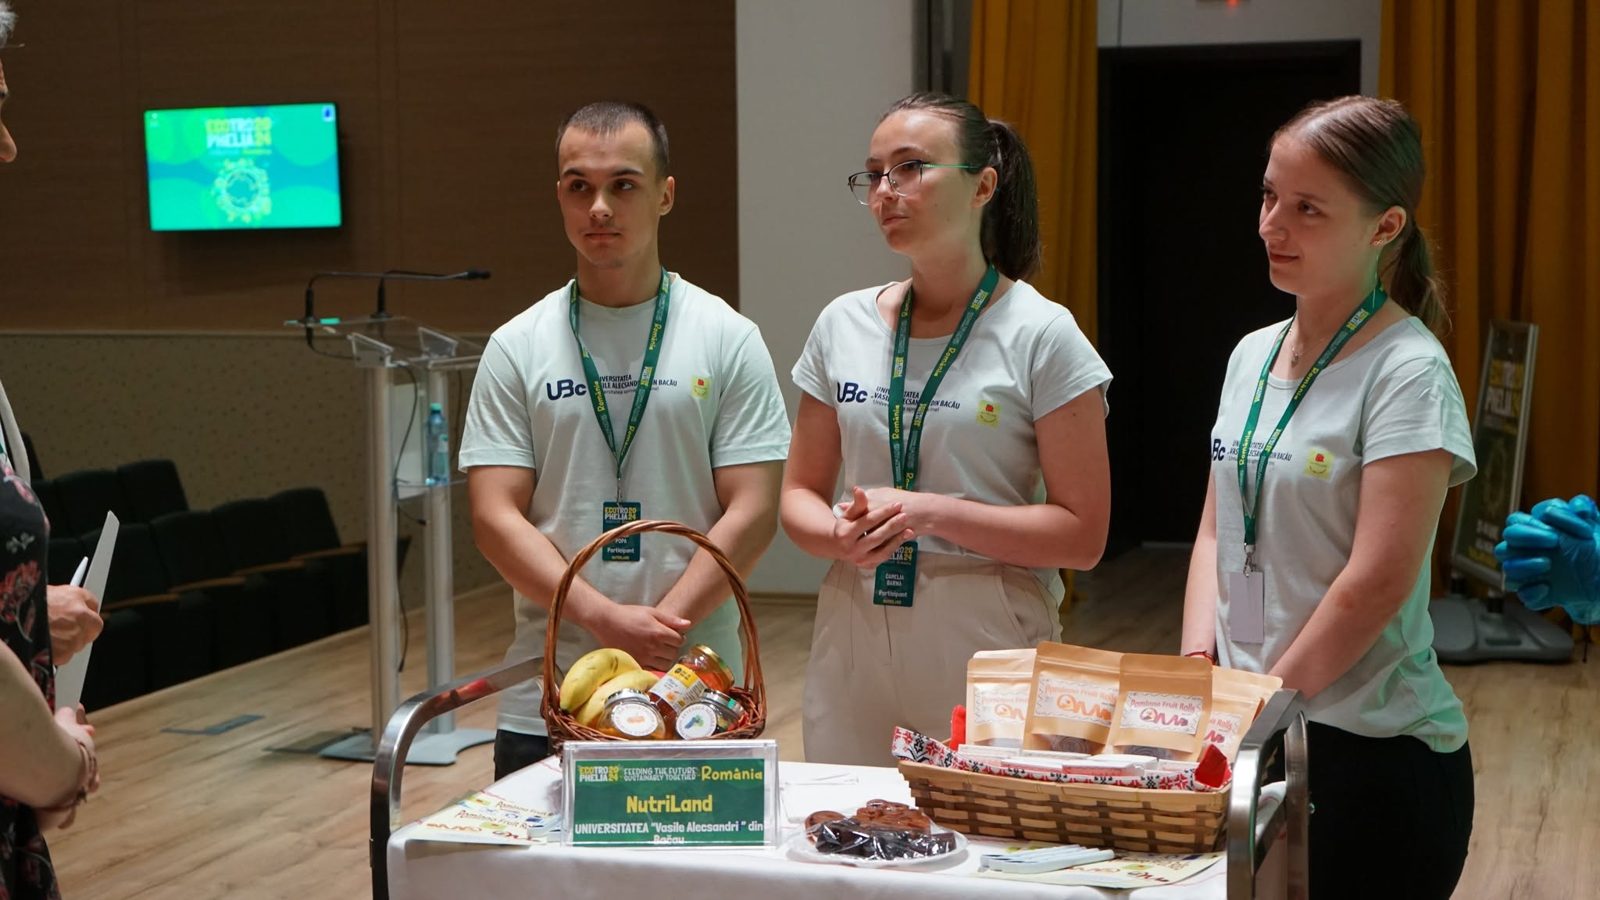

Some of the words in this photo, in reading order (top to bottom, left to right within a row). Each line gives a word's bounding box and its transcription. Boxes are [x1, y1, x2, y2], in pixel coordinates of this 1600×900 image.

[546, 379, 587, 401] UBc
[1212, 438, 1226, 461] Bc
[579, 766, 609, 775] ECOTRO
[579, 773, 608, 782] PHELIA
[624, 767, 653, 775] FEEDING
[669, 766, 696, 774] FUTURE
[701, 765, 763, 781] România
[626, 794, 713, 813] NutriLand
[575, 822, 649, 834] UNIVERSITATEA
[748, 821, 763, 831] din
